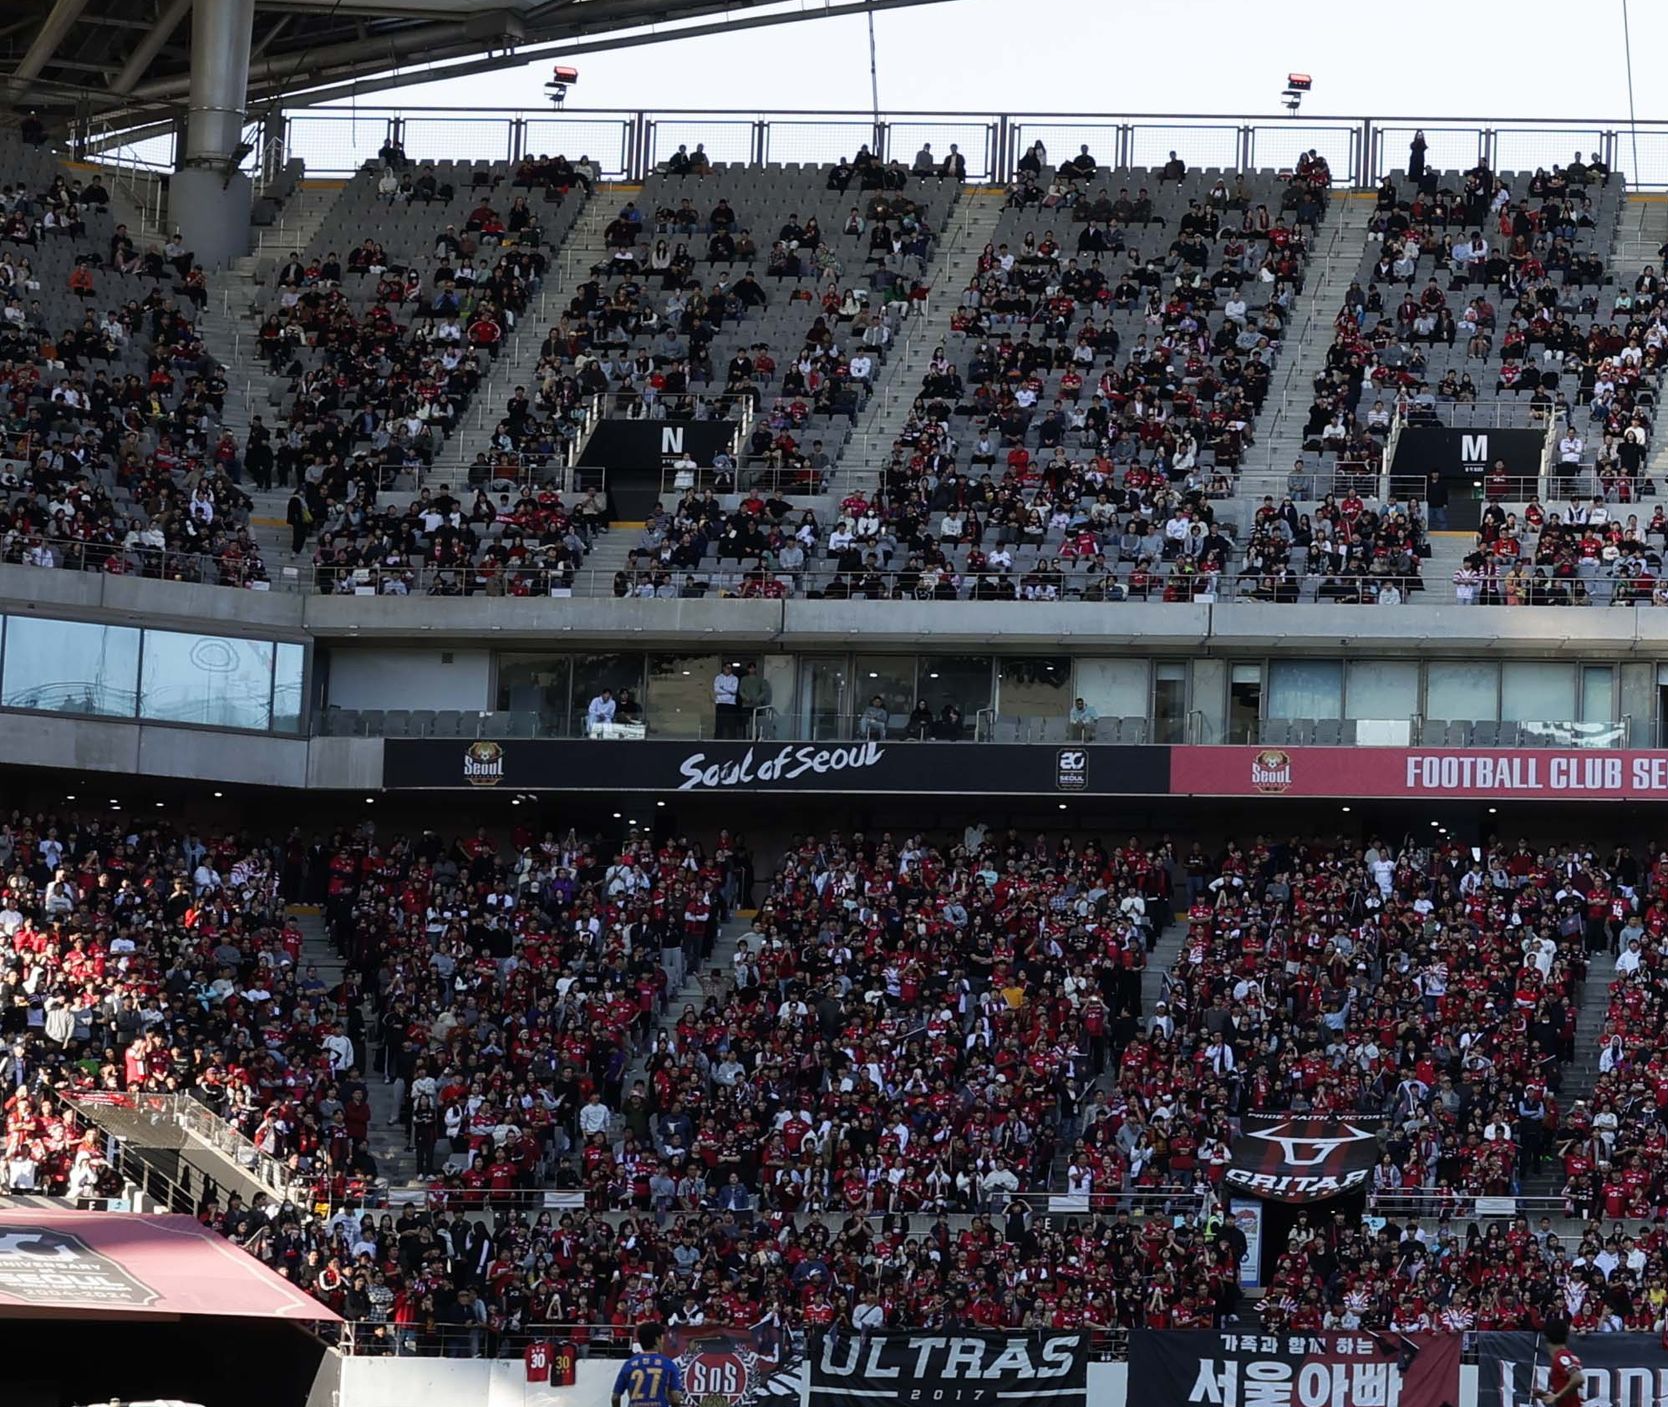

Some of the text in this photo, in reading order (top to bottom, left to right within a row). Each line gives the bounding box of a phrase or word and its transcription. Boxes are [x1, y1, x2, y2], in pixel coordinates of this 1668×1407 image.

[662, 426, 684, 454] N
[1460, 434, 1489, 462] M
[464, 755, 504, 775] Seoul
[678, 742, 885, 790] Soul of Seoul
[1251, 762, 1292, 784] Seoul
[1406, 756, 1543, 788] FOOTBALL
[1549, 757, 1623, 790] CLUB
[1225, 1168, 1369, 1192] GRITAR
[820, 1335, 1081, 1379] ULTRAS
[1220, 1334, 1278, 1354] 가족과
[1336, 1337, 1374, 1355] 하는
[530, 1353, 546, 1368] 30
[555, 1355, 570, 1370] 30
[631, 1368, 663, 1400] 27
[911, 1389, 985, 1401] 2017
[1188, 1358, 1404, 1407] 서울아빠
